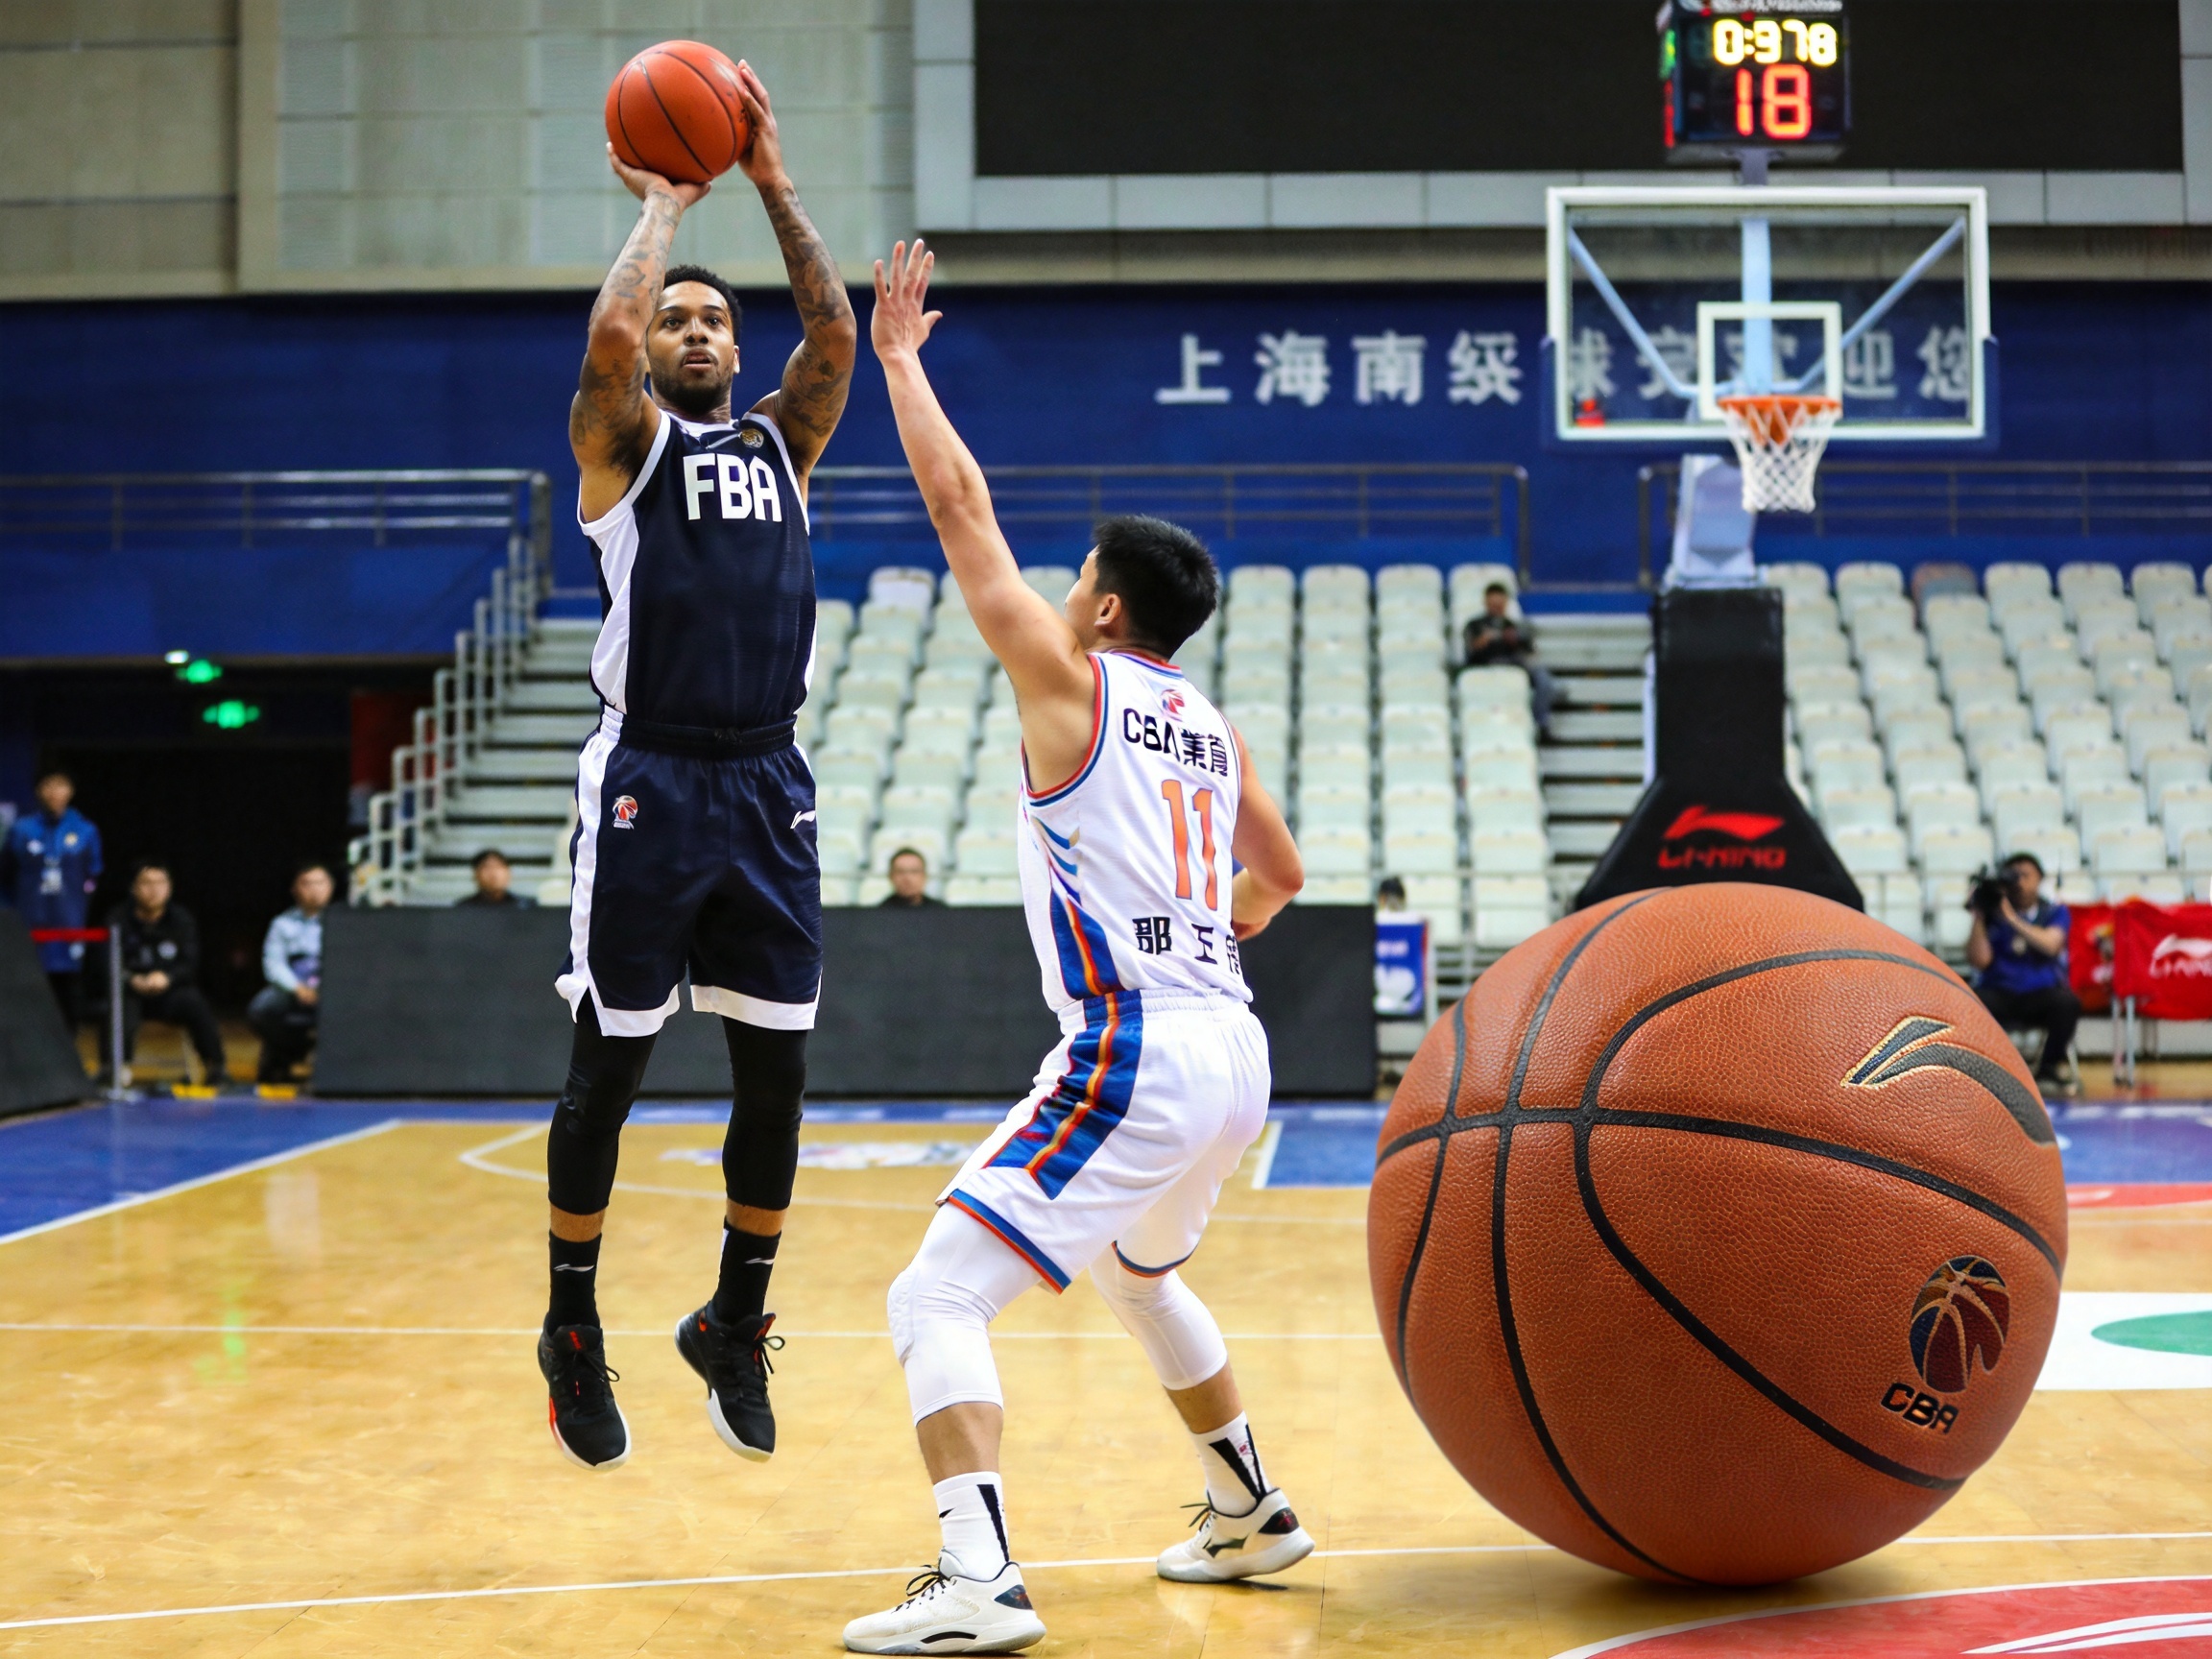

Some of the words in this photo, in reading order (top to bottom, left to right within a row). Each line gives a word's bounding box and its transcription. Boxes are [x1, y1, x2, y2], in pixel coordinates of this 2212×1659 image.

[1736, 63, 1812, 139] 18
[683, 453, 782, 522] FBA
[1161, 779, 1218, 911] 11
[1880, 1382, 1960, 1434] CBA
